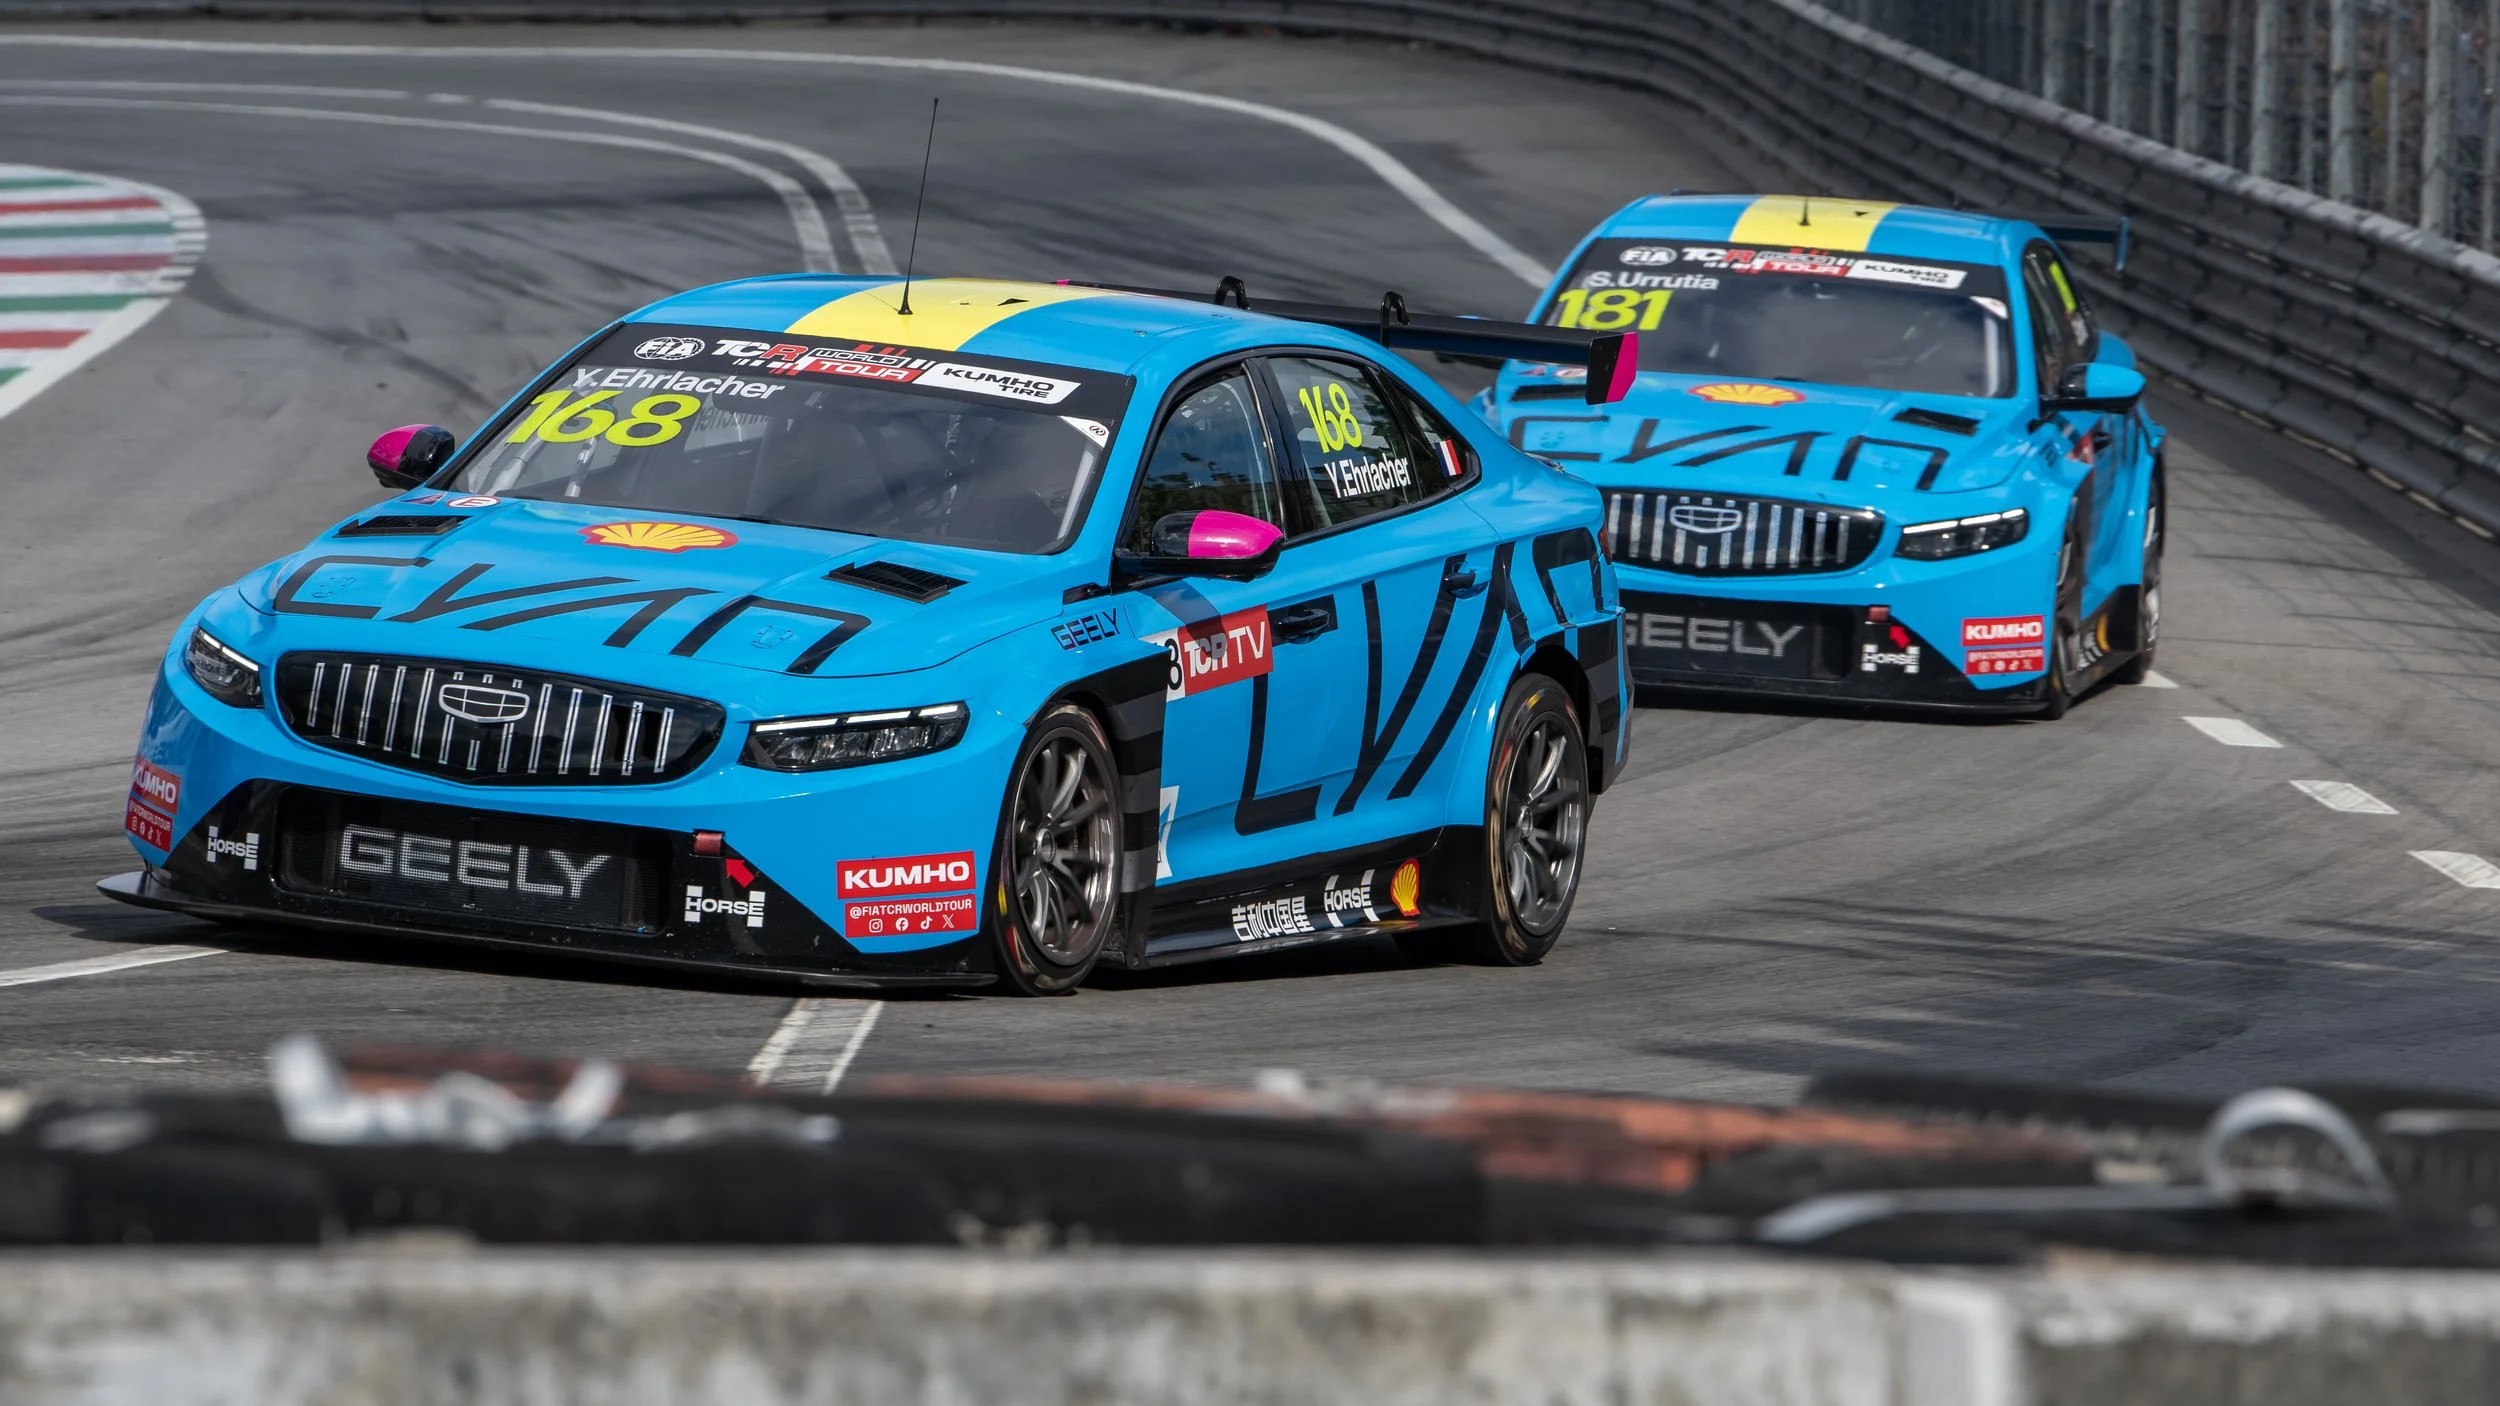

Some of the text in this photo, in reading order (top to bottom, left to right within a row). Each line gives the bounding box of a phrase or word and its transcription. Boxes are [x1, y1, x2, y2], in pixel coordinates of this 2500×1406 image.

[1682, 247, 1756, 264] TCR
[1770, 262, 1841, 275] TOUR
[1588, 270, 1720, 290] S.Urrutia
[1557, 288, 1675, 331] 181
[711, 339, 809, 362] TCR
[815, 350, 902, 365] WORLD
[572, 368, 786, 400] Y.Ehrlacher
[819, 360, 911, 380] TOUR
[943, 368, 1055, 392] KUMHO
[998, 384, 1051, 399] TIRE
[505, 389, 702, 447] 168
[1298, 383, 1363, 454] 168
[1323, 452, 1410, 499] Y.Ehrlacher
[1049, 607, 1121, 651] GEELY
[1965, 621, 2042, 640] KUMHO
[1184, 632, 1229, 678] TCR
[1228, 621, 1265, 665] TV
[134, 763, 177, 804] KUMHO
[340, 823, 611, 899] GEELY
[844, 860, 970, 890] KUMHO
[849, 898, 973, 920] @FIATCRWORLDTOUR
[1231, 896, 1316, 942] 吉利中国星
